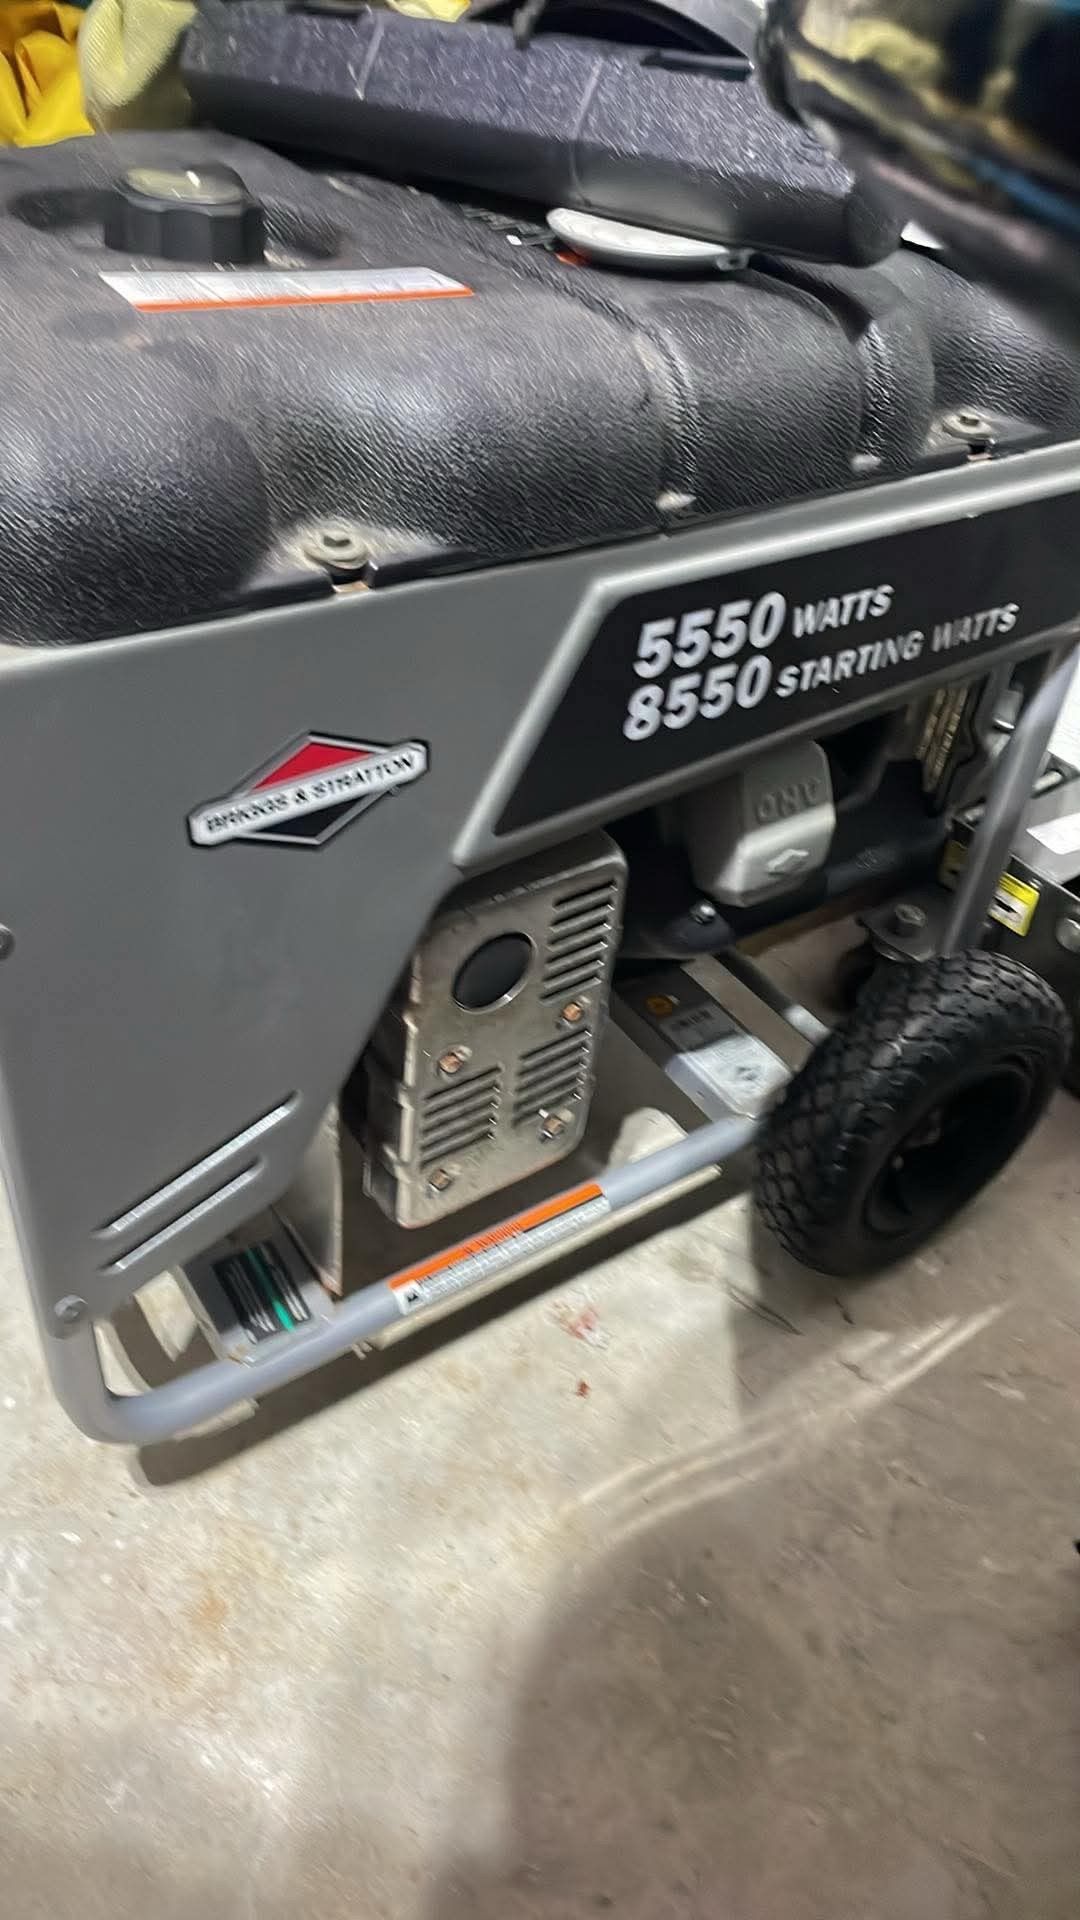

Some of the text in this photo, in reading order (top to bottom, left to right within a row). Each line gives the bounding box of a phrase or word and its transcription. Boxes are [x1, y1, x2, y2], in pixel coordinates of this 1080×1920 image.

[623, 602, 1020, 741] 8550 STARTING WATTS
[633, 584, 895, 679] 5550 WATTS
